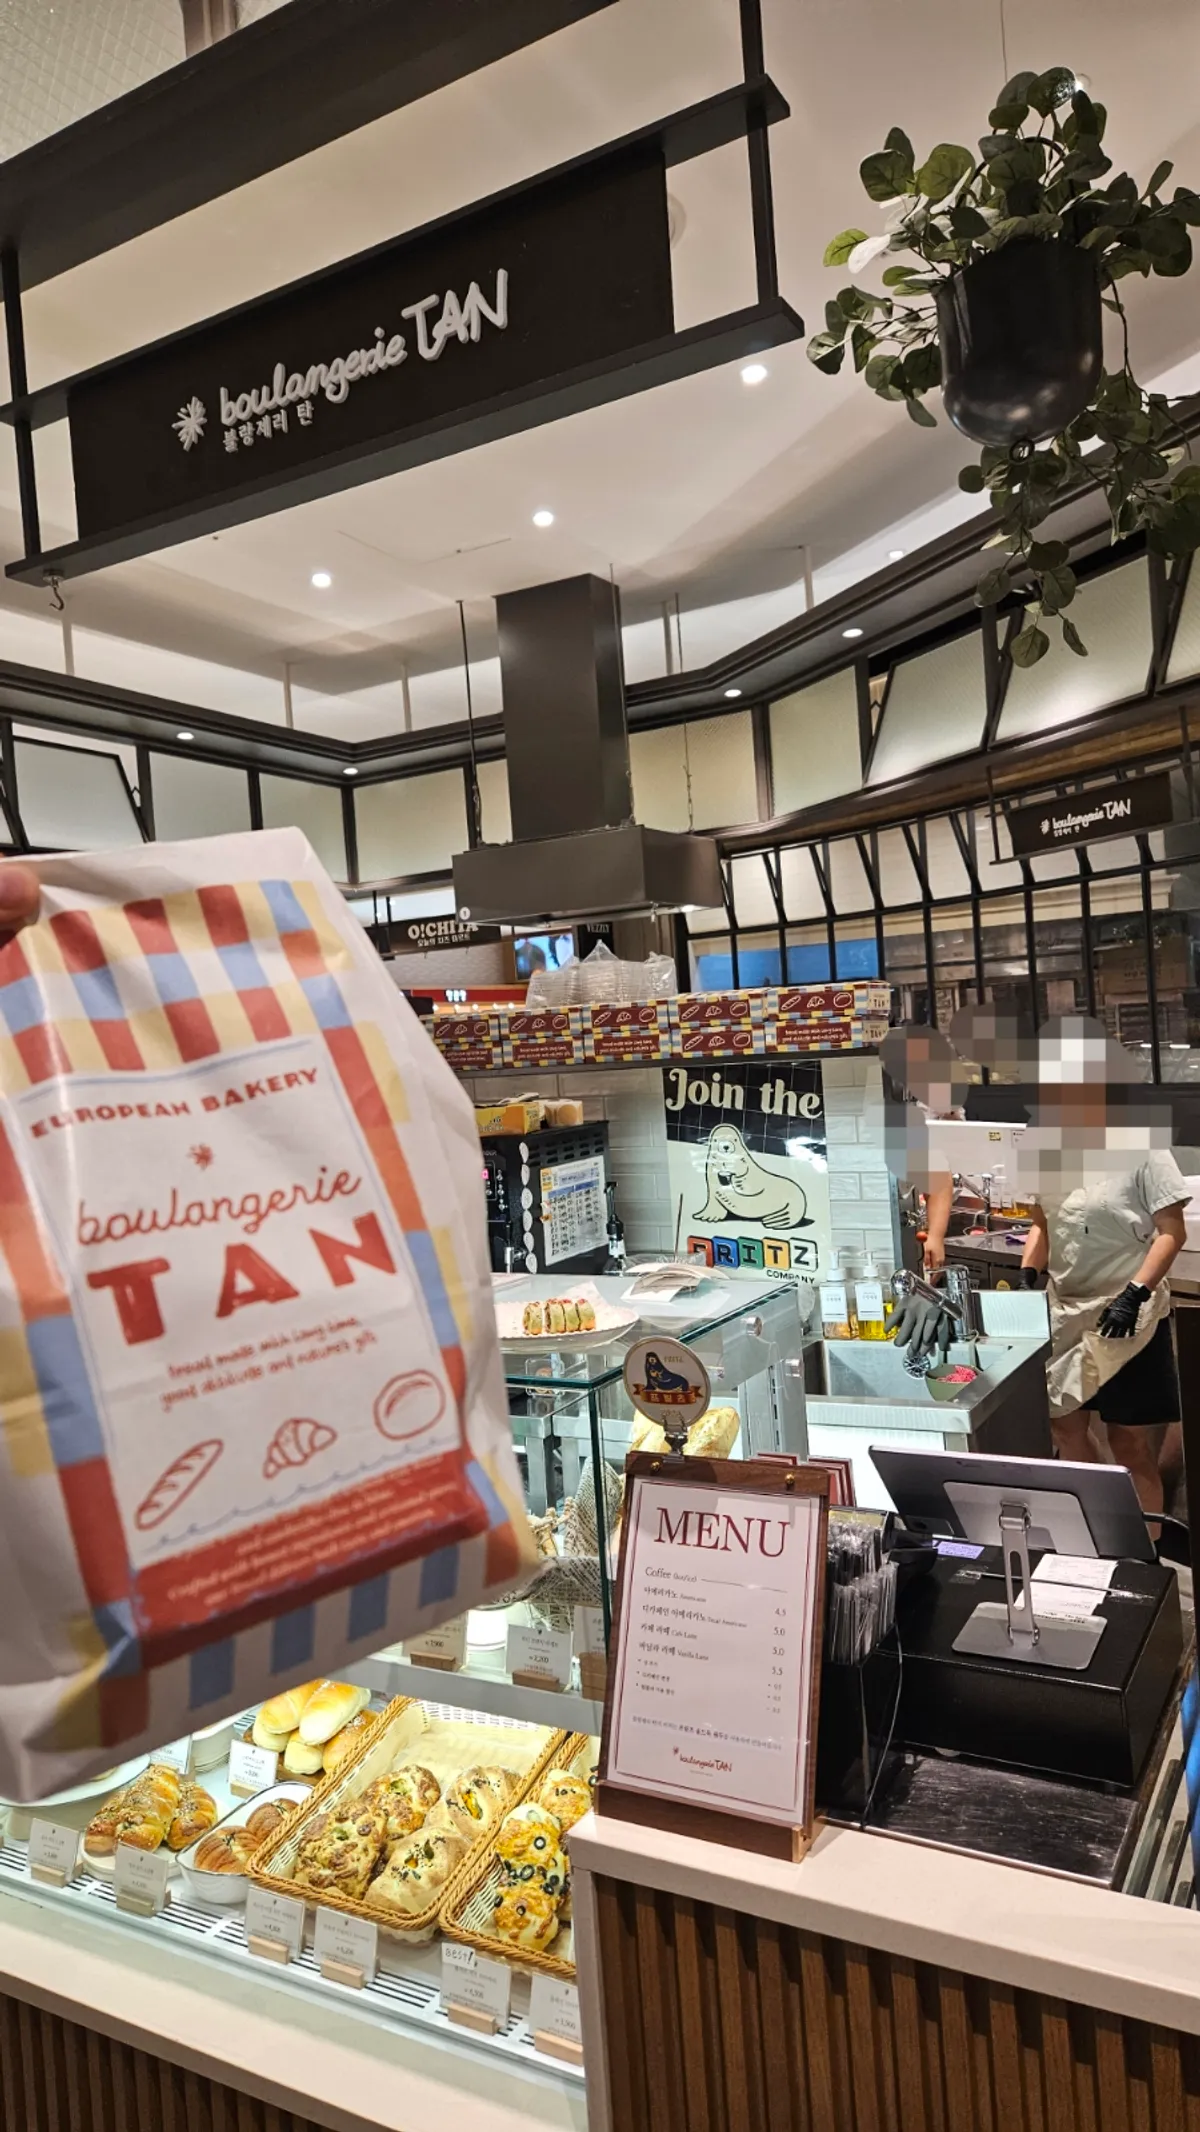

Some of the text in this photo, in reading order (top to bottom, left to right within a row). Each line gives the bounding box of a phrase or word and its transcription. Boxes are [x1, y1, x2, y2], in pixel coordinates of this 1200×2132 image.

[220, 268, 508, 427] boulangerie TAN
[295, 399, 315, 426] 탄
[1102, 798, 1131, 820] TAN
[29, 1067, 318, 1139] EUROPEAN BAKERY
[665, 1067, 823, 1119] Join the
[78, 1165, 362, 1247] boulangerie
[86, 1210, 398, 1346] TAN
[653, 1506, 791, 1558] MENU
[644, 1566, 672, 1580] Coffee
[643, 1586, 678, 1599] 아메리카노
[774, 1607, 787, 1617] 4.5
[773, 1627, 786, 1637] 5.0
[772, 1646, 785, 1657] 5.0
[771, 1666, 784, 1676] 5.5
[714, 1759, 733, 1772] TAN
